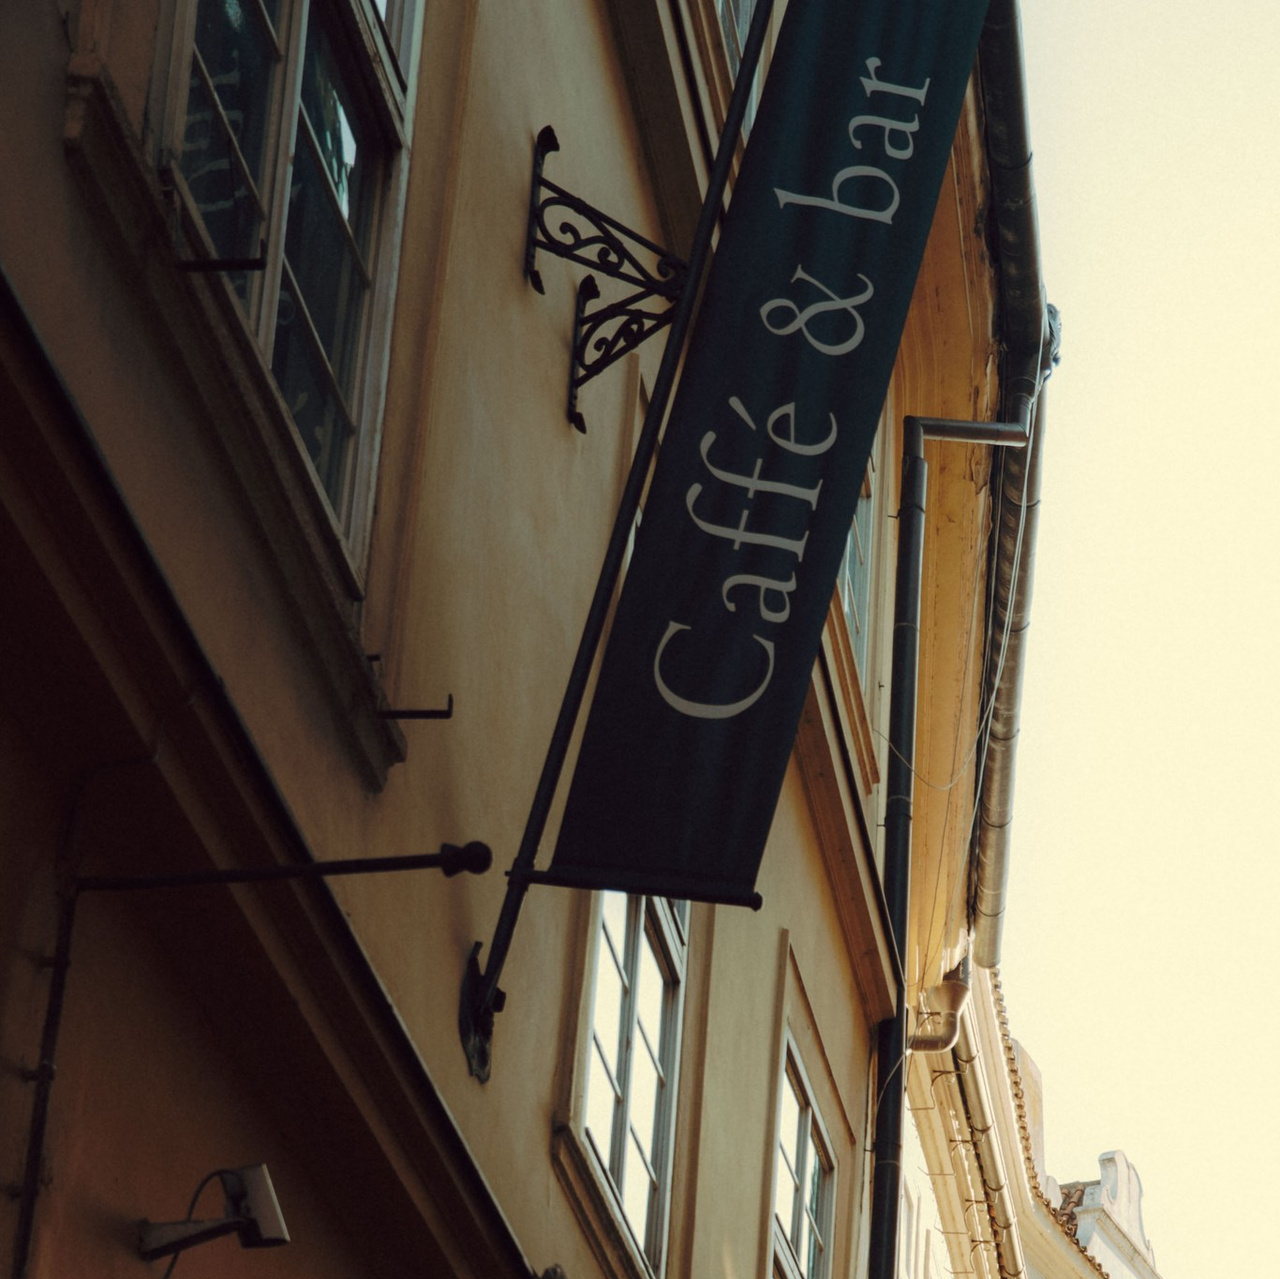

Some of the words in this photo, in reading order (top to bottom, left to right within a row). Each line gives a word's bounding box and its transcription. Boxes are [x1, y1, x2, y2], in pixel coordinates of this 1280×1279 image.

[773, 56, 931, 226] bar
[759, 264, 876, 357] &
[653, 395, 838, 720] Caffé
